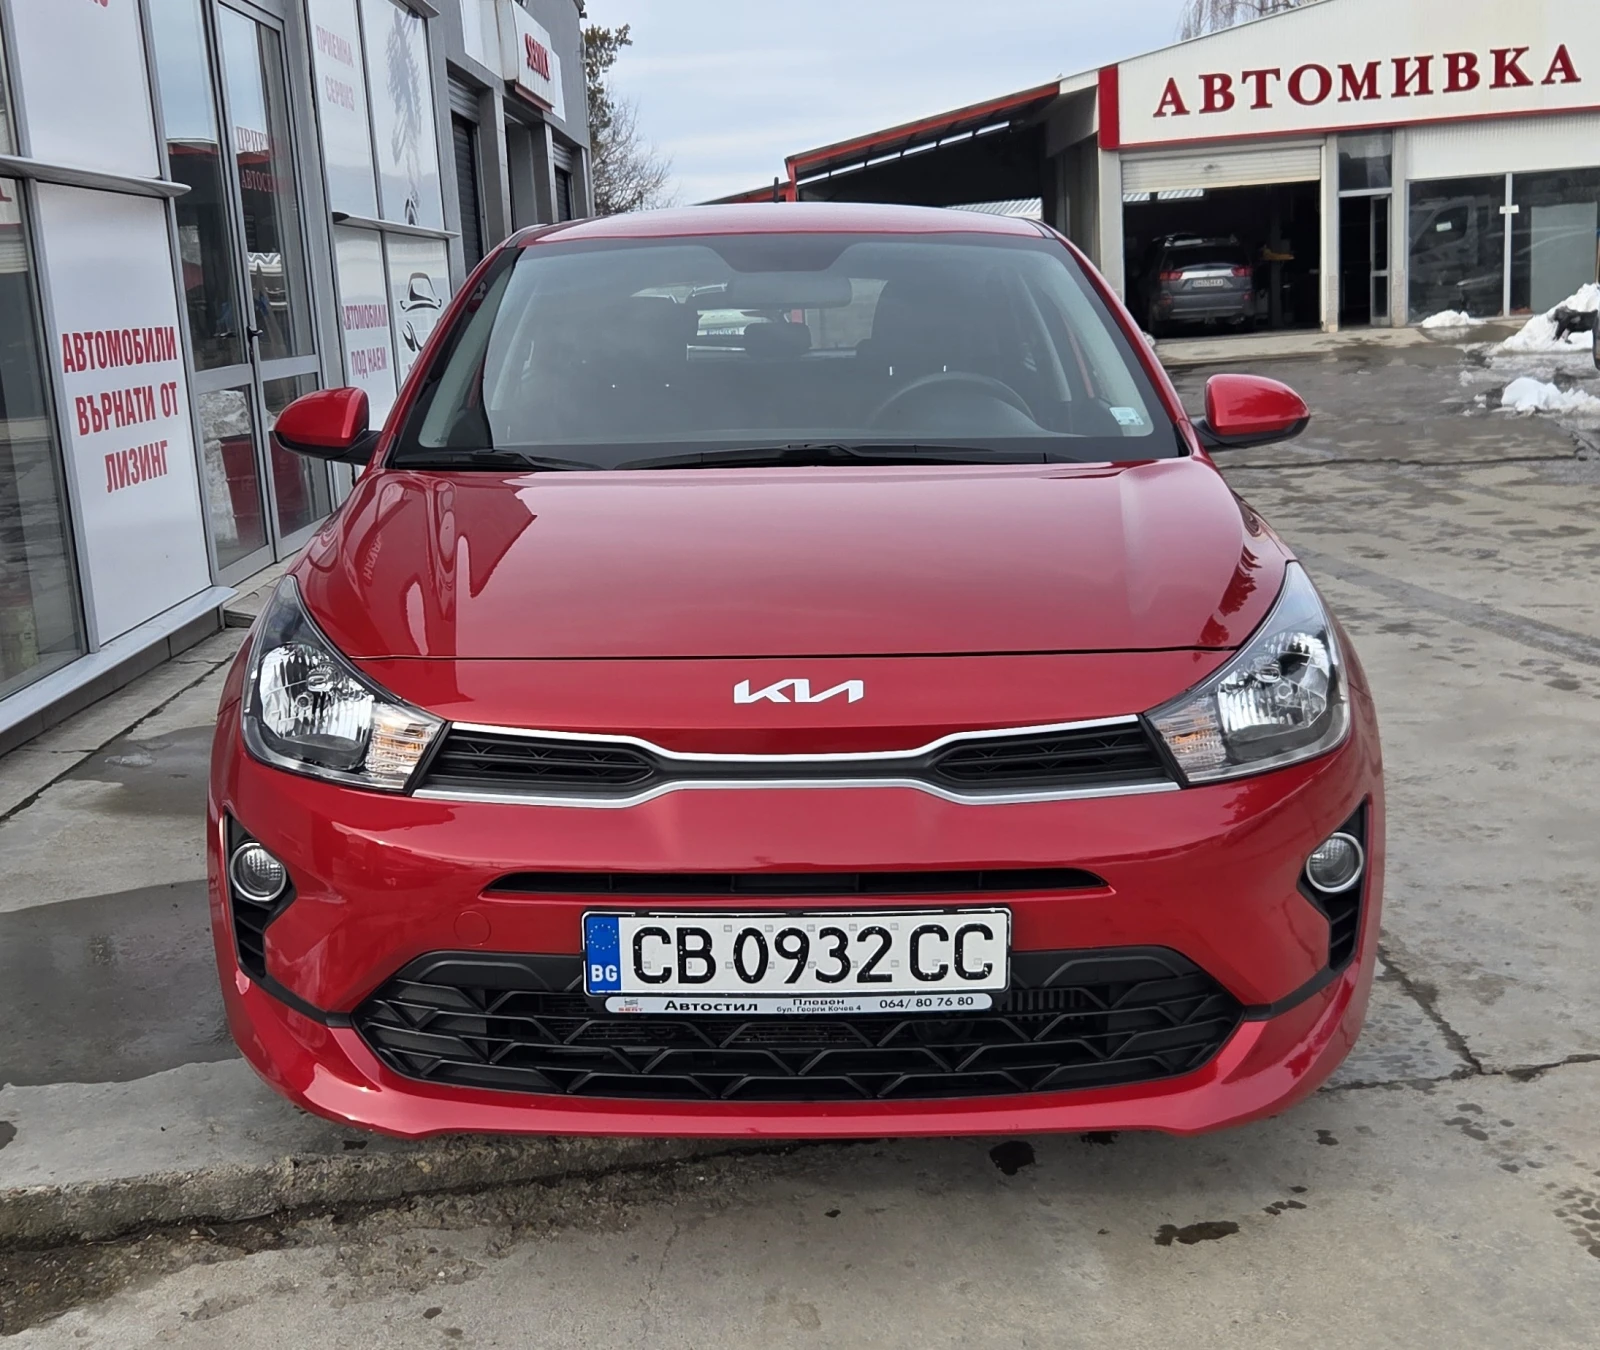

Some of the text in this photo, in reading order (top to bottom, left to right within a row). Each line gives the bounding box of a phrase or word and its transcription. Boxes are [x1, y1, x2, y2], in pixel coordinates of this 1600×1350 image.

[1153, 44, 1582, 118] АВТОМИВКА
[62, 326, 177, 373] АВТОМОБИЛИ
[351, 346, 388, 380] ПОД НАЕМ
[75, 381, 178, 436] ВЪРНАТИ ОТ
[104, 439, 168, 493] ЛИЗИНГ
[733, 678, 864, 704] KIA
[591, 964, 618, 982] BG
[632, 923, 994, 984] CB 0932 CC
[664, 1000, 758, 1012] Автостил
[879, 996, 974, 1009] 064/ 80 76 80
